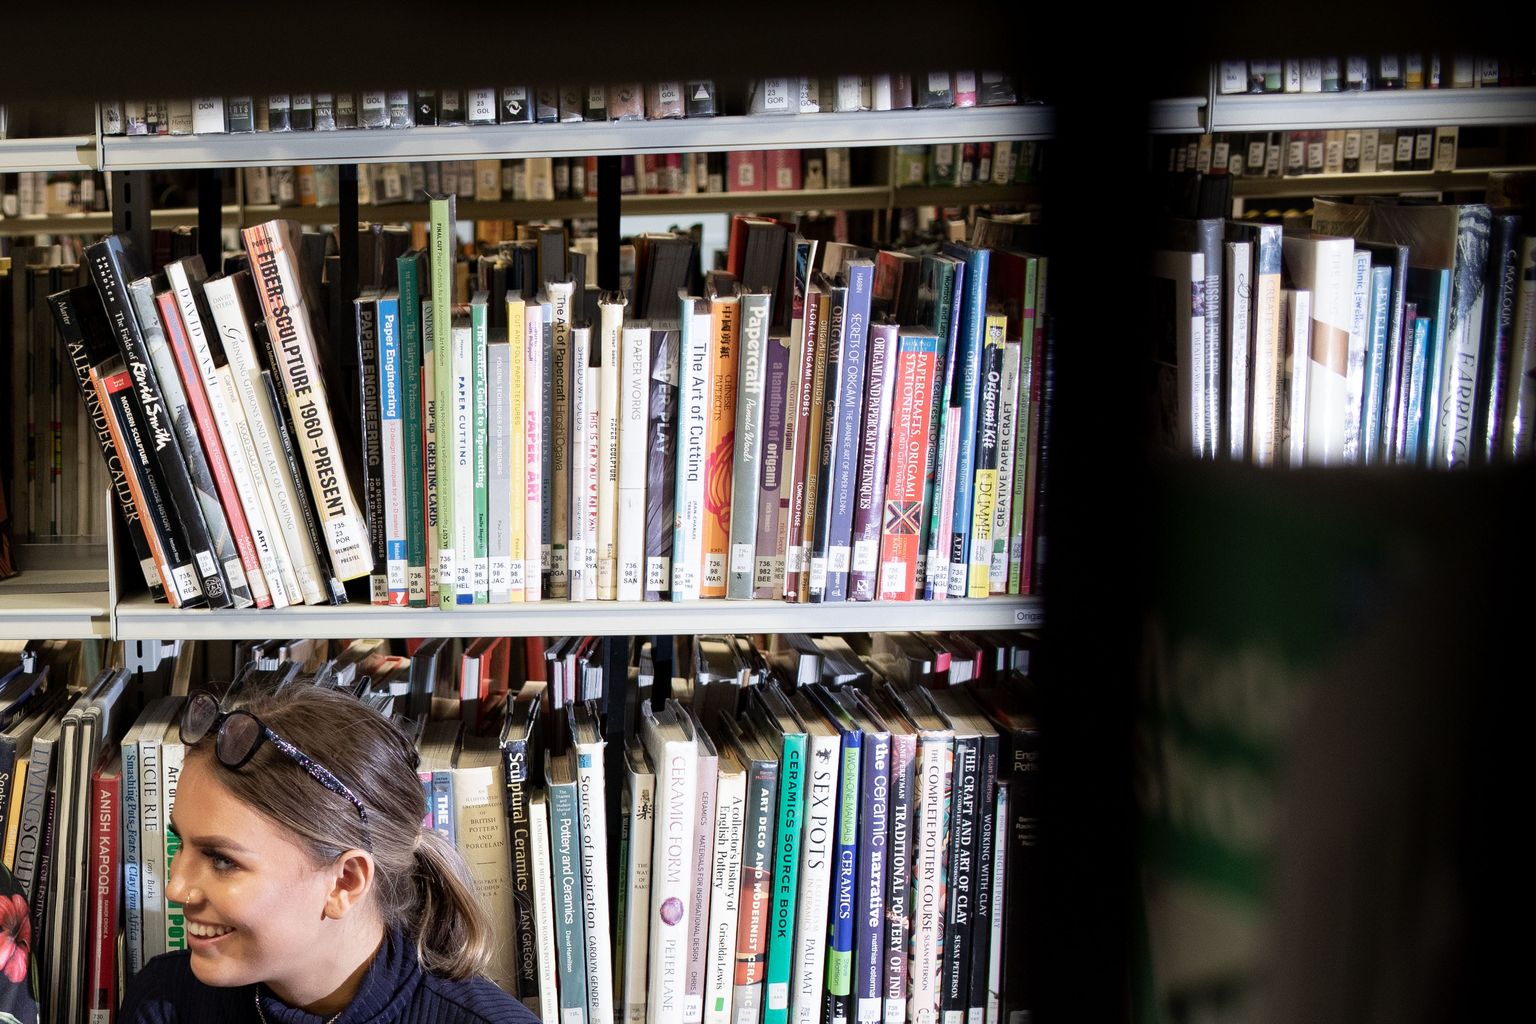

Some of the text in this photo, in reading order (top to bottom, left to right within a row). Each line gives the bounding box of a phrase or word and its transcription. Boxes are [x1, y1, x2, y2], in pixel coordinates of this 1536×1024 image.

[100, 255, 116, 287] SMITH
[251, 236, 274, 249] PORTER
[95, 257, 115, 303] SANDLER
[1502, 264, 1518, 328] MAZLOUM
[179, 287, 202, 338] DAVID
[199, 343, 219, 387] NASH
[272, 304, 313, 399] SCULPTURE
[384, 314, 397, 418] Paper Engineering
[743, 304, 763, 394] Papercraft
[801, 302, 818, 418] FLORAL ORIGAMI GLOBES
[360, 309, 380, 467] PAPER ENGINEERING
[554, 347, 567, 402] Papercraft
[631, 339, 644, 421] PAPER WORKS
[692, 343, 708, 400] The Art
[899, 352, 917, 429] STATIONERY
[963, 350, 976, 400] Origami
[130, 426, 149, 465] SCULPTURE
[458, 376, 468, 467] PAPER CUTTING
[106, 451, 141, 526] CALDER
[427, 441, 438, 491] GREETING
[765, 442, 778, 488] origami
[905, 441, 921, 499] ORIGAMI
[996, 400, 1013, 529] CREATIVE PAPER CRAFT
[335, 536, 351, 545] POR
[429, 493, 439, 528] CARDS
[182, 586, 198, 594] REA
[340, 555, 361, 564] PRESTEL
[705, 575, 722, 583] WAR
[143, 746, 158, 832] LUCIE RIE
[437, 794, 449, 826] THE
[756, 787, 770, 812] ART
[811, 770, 831, 809] SEX
[872, 743, 890, 847] the ceramic
[97, 788, 112, 897] ANISH KAPOOR
[465, 841, 505, 850] PORCELAIN
[507, 752, 528, 892] Sculptural Ceramics
[580, 775, 597, 930] Sources Inspiration
[755, 814, 768, 849] DECO
[776, 749, 800, 939] CERAMICS SOURCE BOOK
[807, 814, 829, 870] POTS
[893, 803, 907, 896] TRADITIONAL
[922, 765, 940, 933] COMPLETE POTTERY COURSE
[955, 747, 976, 926] THE CRAFT AND ART CLAY
[980, 814, 992, 861] WORKING
[146, 858, 156, 899] Tony Birks
[558, 817, 575, 925] Pottery Ceramics
[662, 755, 687, 1013] CERAMIC FORM PETER LANE
[713, 805, 731, 962] English Pottery Griselda
[753, 851, 765, 880] AND
[839, 850, 855, 919] CERAMICS
[748, 880, 764, 951] MODERNIST
[521, 930, 535, 982] GREGORY
